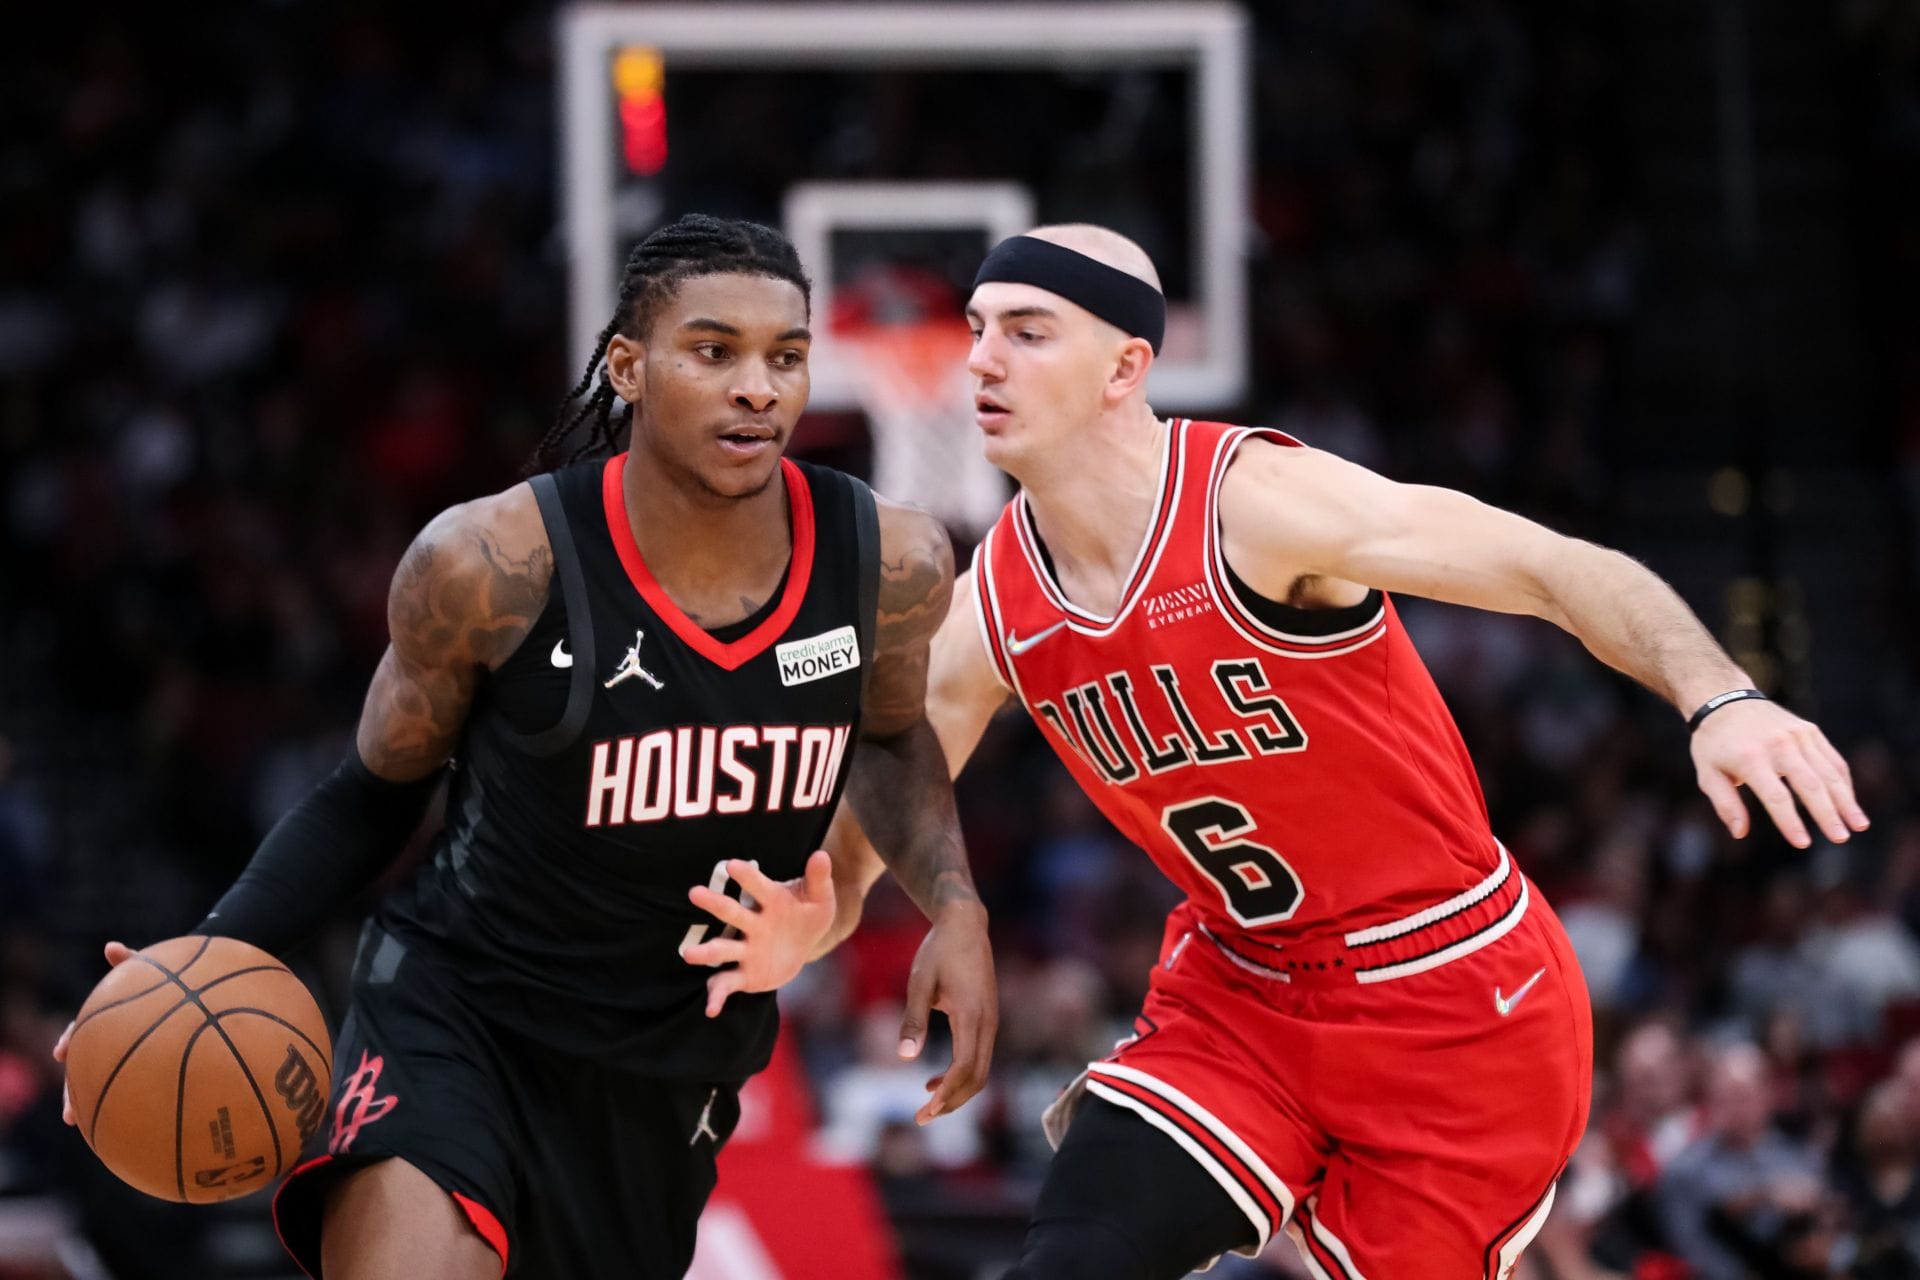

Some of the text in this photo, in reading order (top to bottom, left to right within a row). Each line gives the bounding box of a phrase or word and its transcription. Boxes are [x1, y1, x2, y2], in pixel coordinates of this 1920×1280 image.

[1142, 582, 1208, 616] ZENNI
[1148, 601, 1212, 629] EYEWEAR
[780, 634, 854, 662] credit karma
[782, 645, 853, 682] MONEY
[1161, 795, 1305, 928] 6
